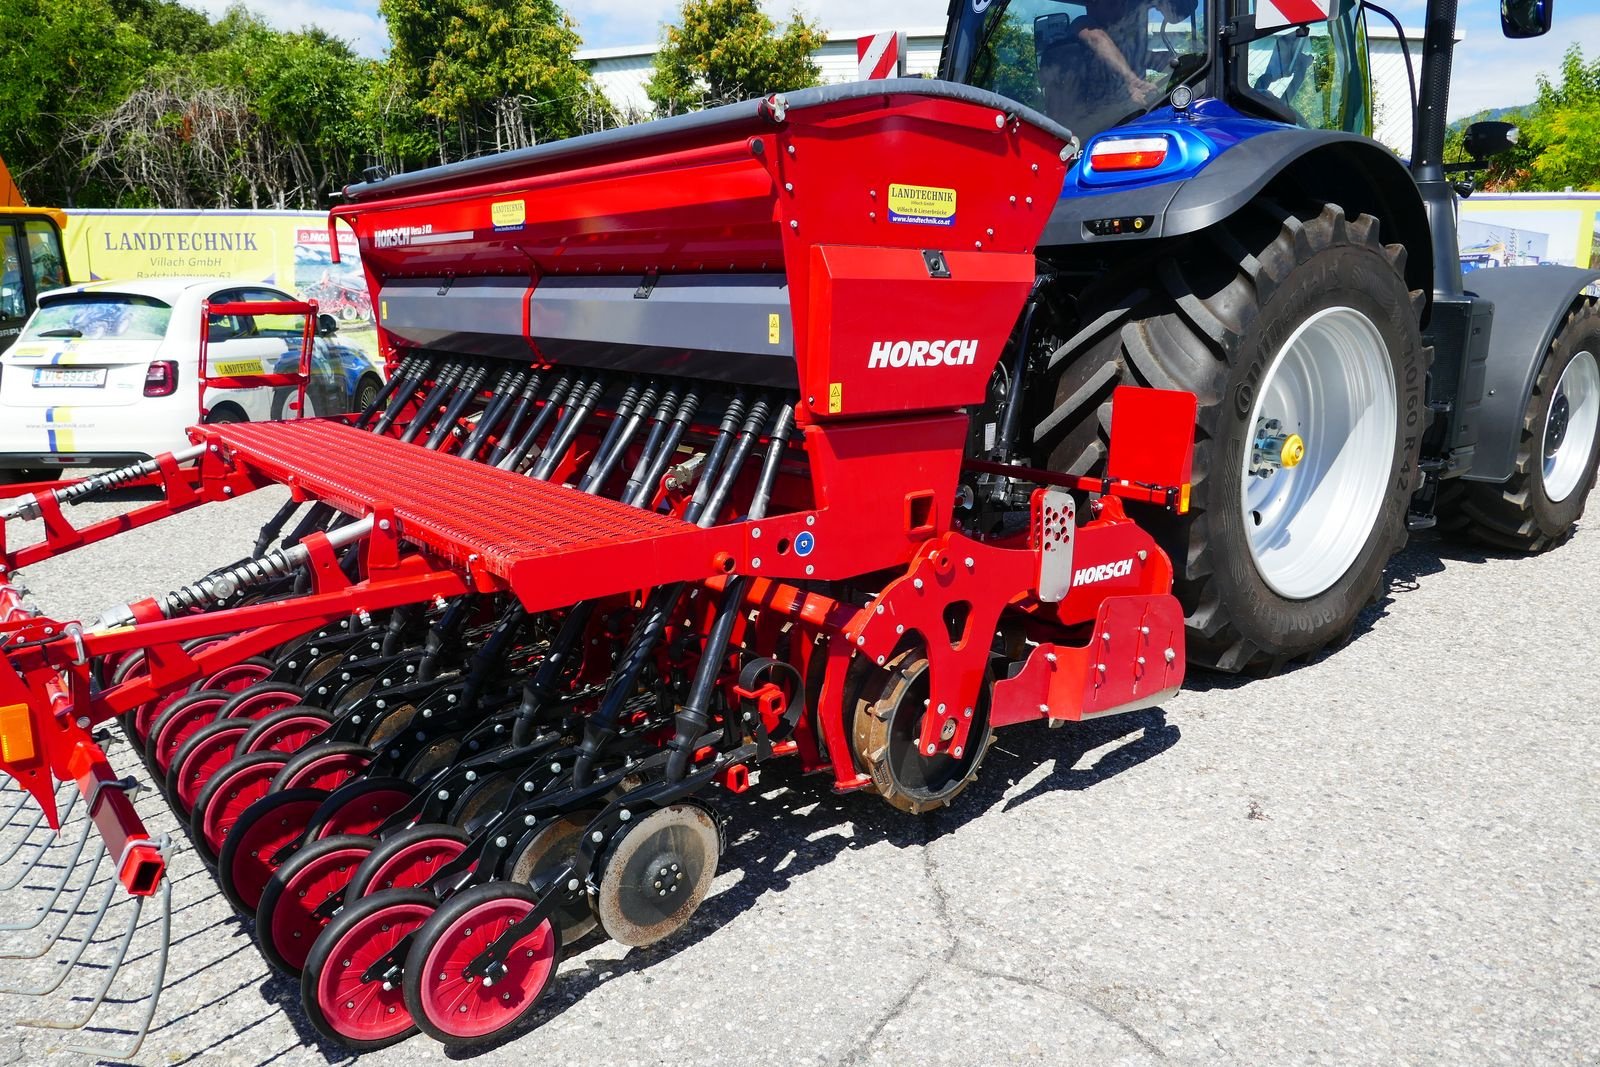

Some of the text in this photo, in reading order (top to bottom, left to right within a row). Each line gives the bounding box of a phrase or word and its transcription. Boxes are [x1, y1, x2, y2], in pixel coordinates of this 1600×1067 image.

[892, 188, 952, 202] LANDTECHNIK
[892, 216, 951, 225] www.landtechnik.co.at
[104, 232, 258, 251] LANDTECHNIK
[375, 228, 410, 248] HORSCH
[422, 225, 426, 234] 3
[150, 257, 222, 267] Villach GmbH
[867, 339, 978, 369] HORSCH
[219, 362, 262, 375] LANDTECHNIK
[1404, 436, 1417, 450] R
[1395, 460, 1411, 491] 42
[1072, 559, 1133, 587] HORSCH
